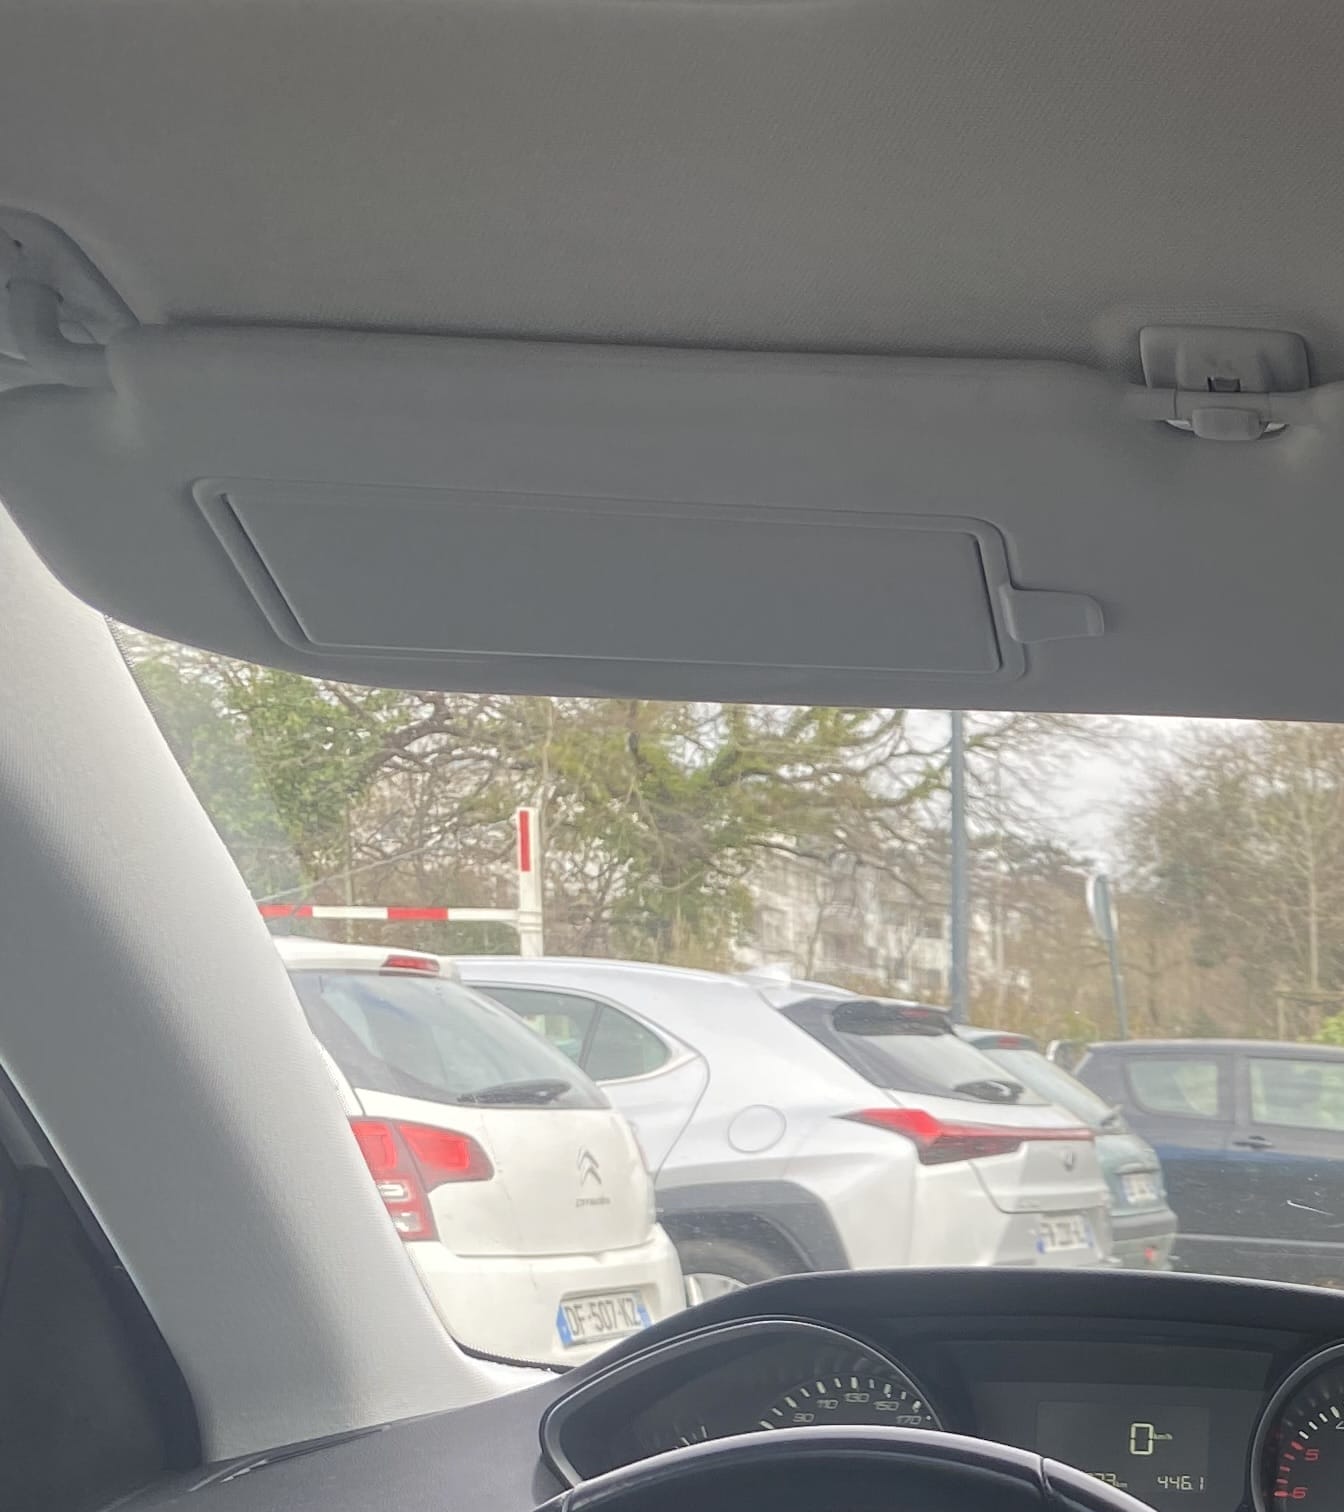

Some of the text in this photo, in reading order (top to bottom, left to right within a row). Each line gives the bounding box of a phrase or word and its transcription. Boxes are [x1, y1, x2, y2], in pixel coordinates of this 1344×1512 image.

[895, 1414, 922, 1425] 170
[1129, 1422, 1154, 1455] 0
[1304, 1448, 1320, 1461] 5
[1291, 1486, 1308, 1499] 6
